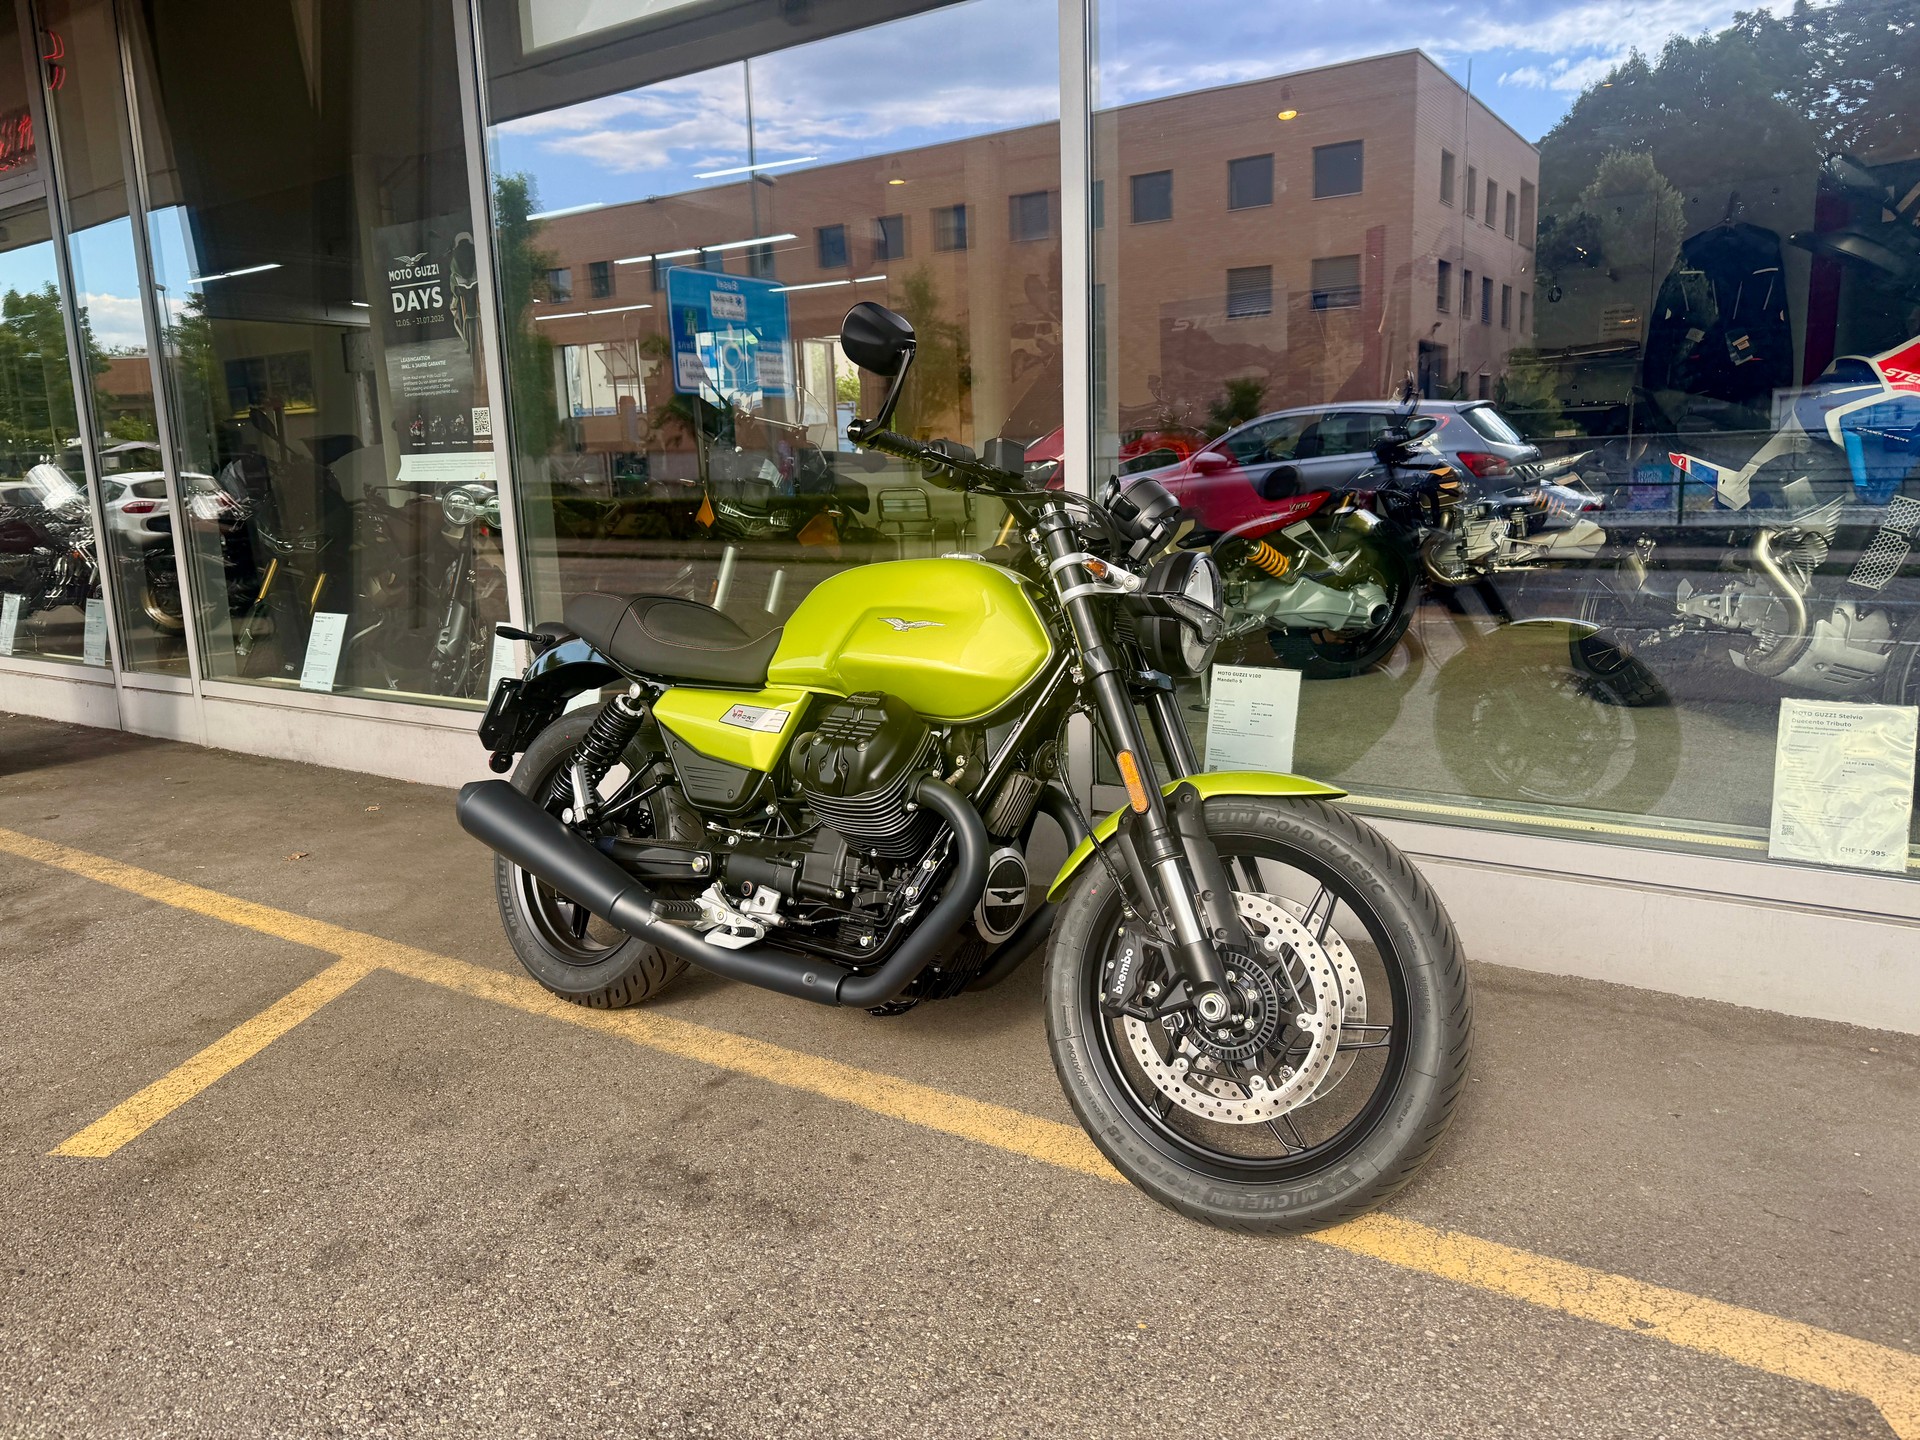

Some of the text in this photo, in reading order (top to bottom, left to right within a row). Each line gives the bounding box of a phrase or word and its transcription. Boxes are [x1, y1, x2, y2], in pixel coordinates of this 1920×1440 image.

[388, 263, 440, 282] MOTO GUZZI
[391, 286, 443, 313] DAYS
[1791, 717, 1852, 728] Duecento Tributo
[1792, 709, 1864, 721] MOTO GUZZI Stelvio
[1263, 816, 1386, 896] ROAD CLASSIC
[1840, 846, 1856, 854] CHF
[1112, 948, 1134, 995] brembo
[1106, 1124, 1126, 1145] 18
[1209, 1187, 1319, 1212] MICHELIN
